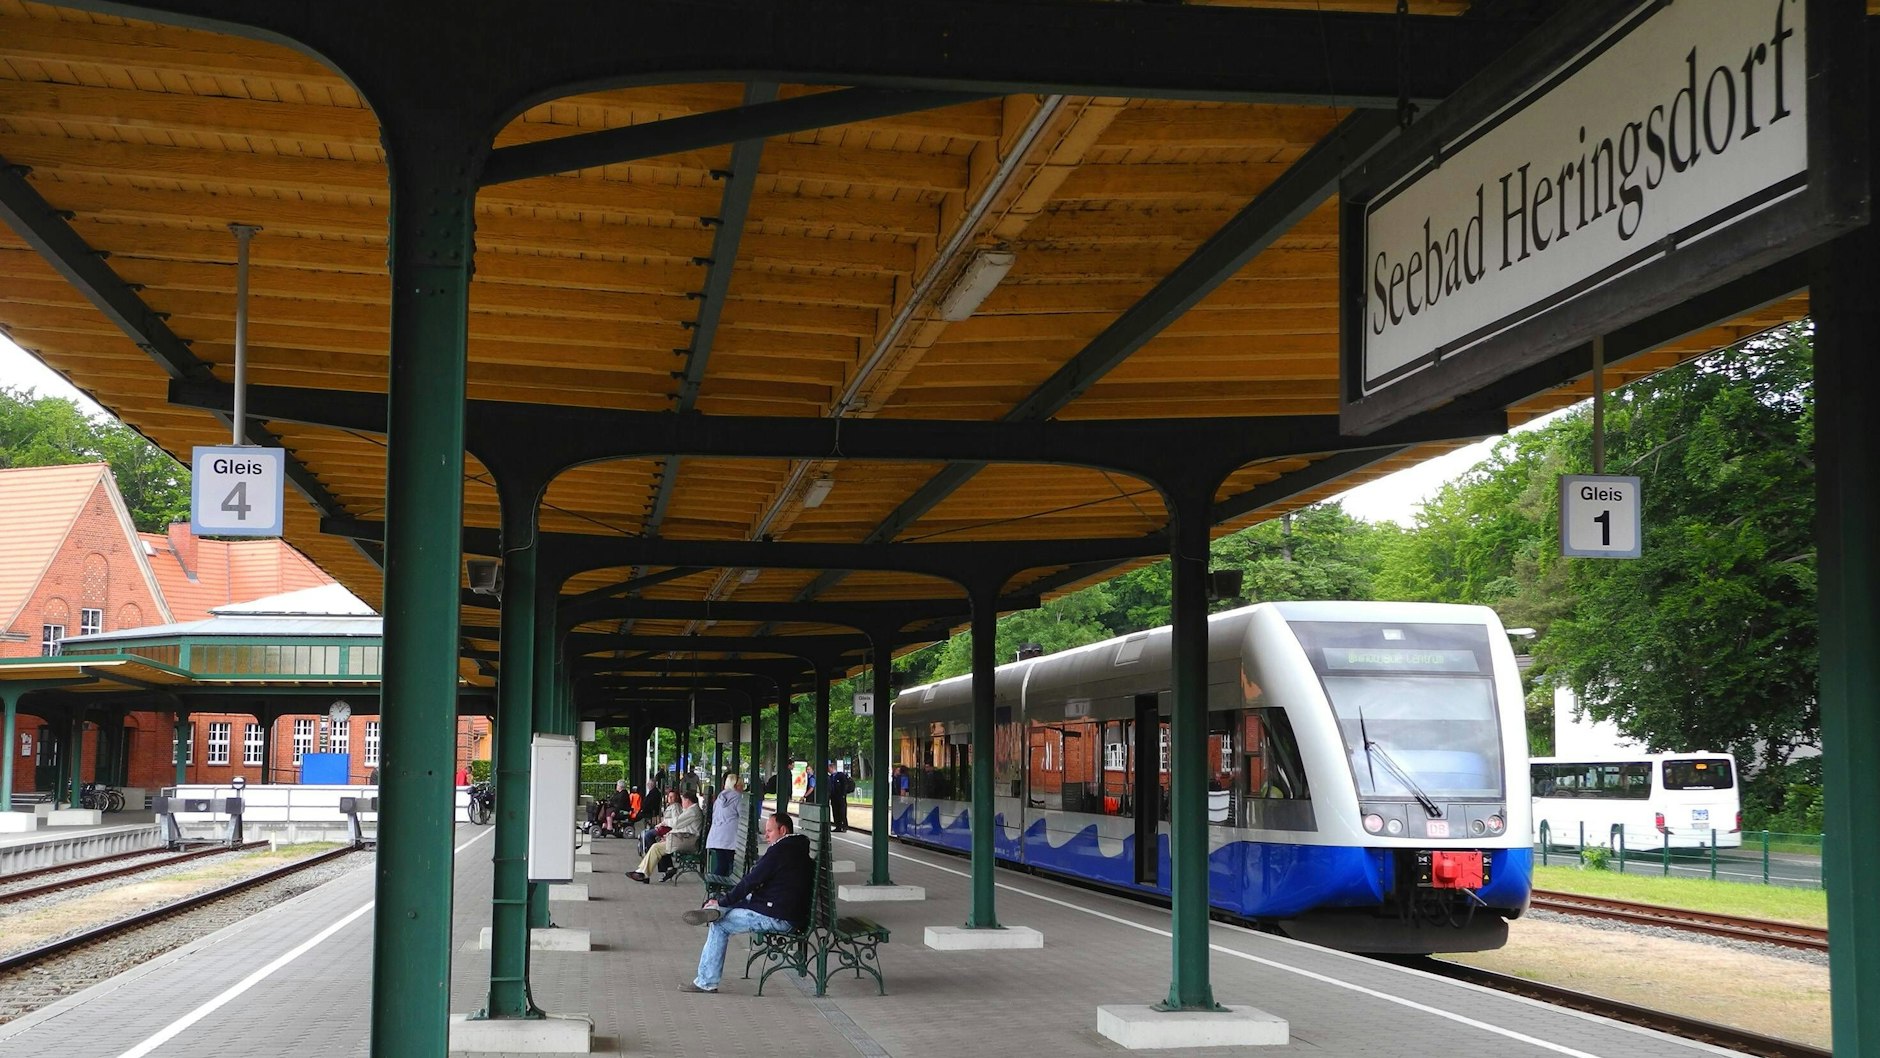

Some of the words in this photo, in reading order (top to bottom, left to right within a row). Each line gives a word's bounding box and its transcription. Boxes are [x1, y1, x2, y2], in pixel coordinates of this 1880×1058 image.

[1373, 183, 1486, 336] Seebad
[1499, 0, 1796, 271] Heringsdorf
[213, 458, 263, 475] Gleis
[220, 481, 252, 521] 4
[1580, 486, 1623, 502] Gleis
[1593, 510, 1610, 546] 1
[862, 702, 867, 713] 1
[1429, 822, 1446, 836] DB
